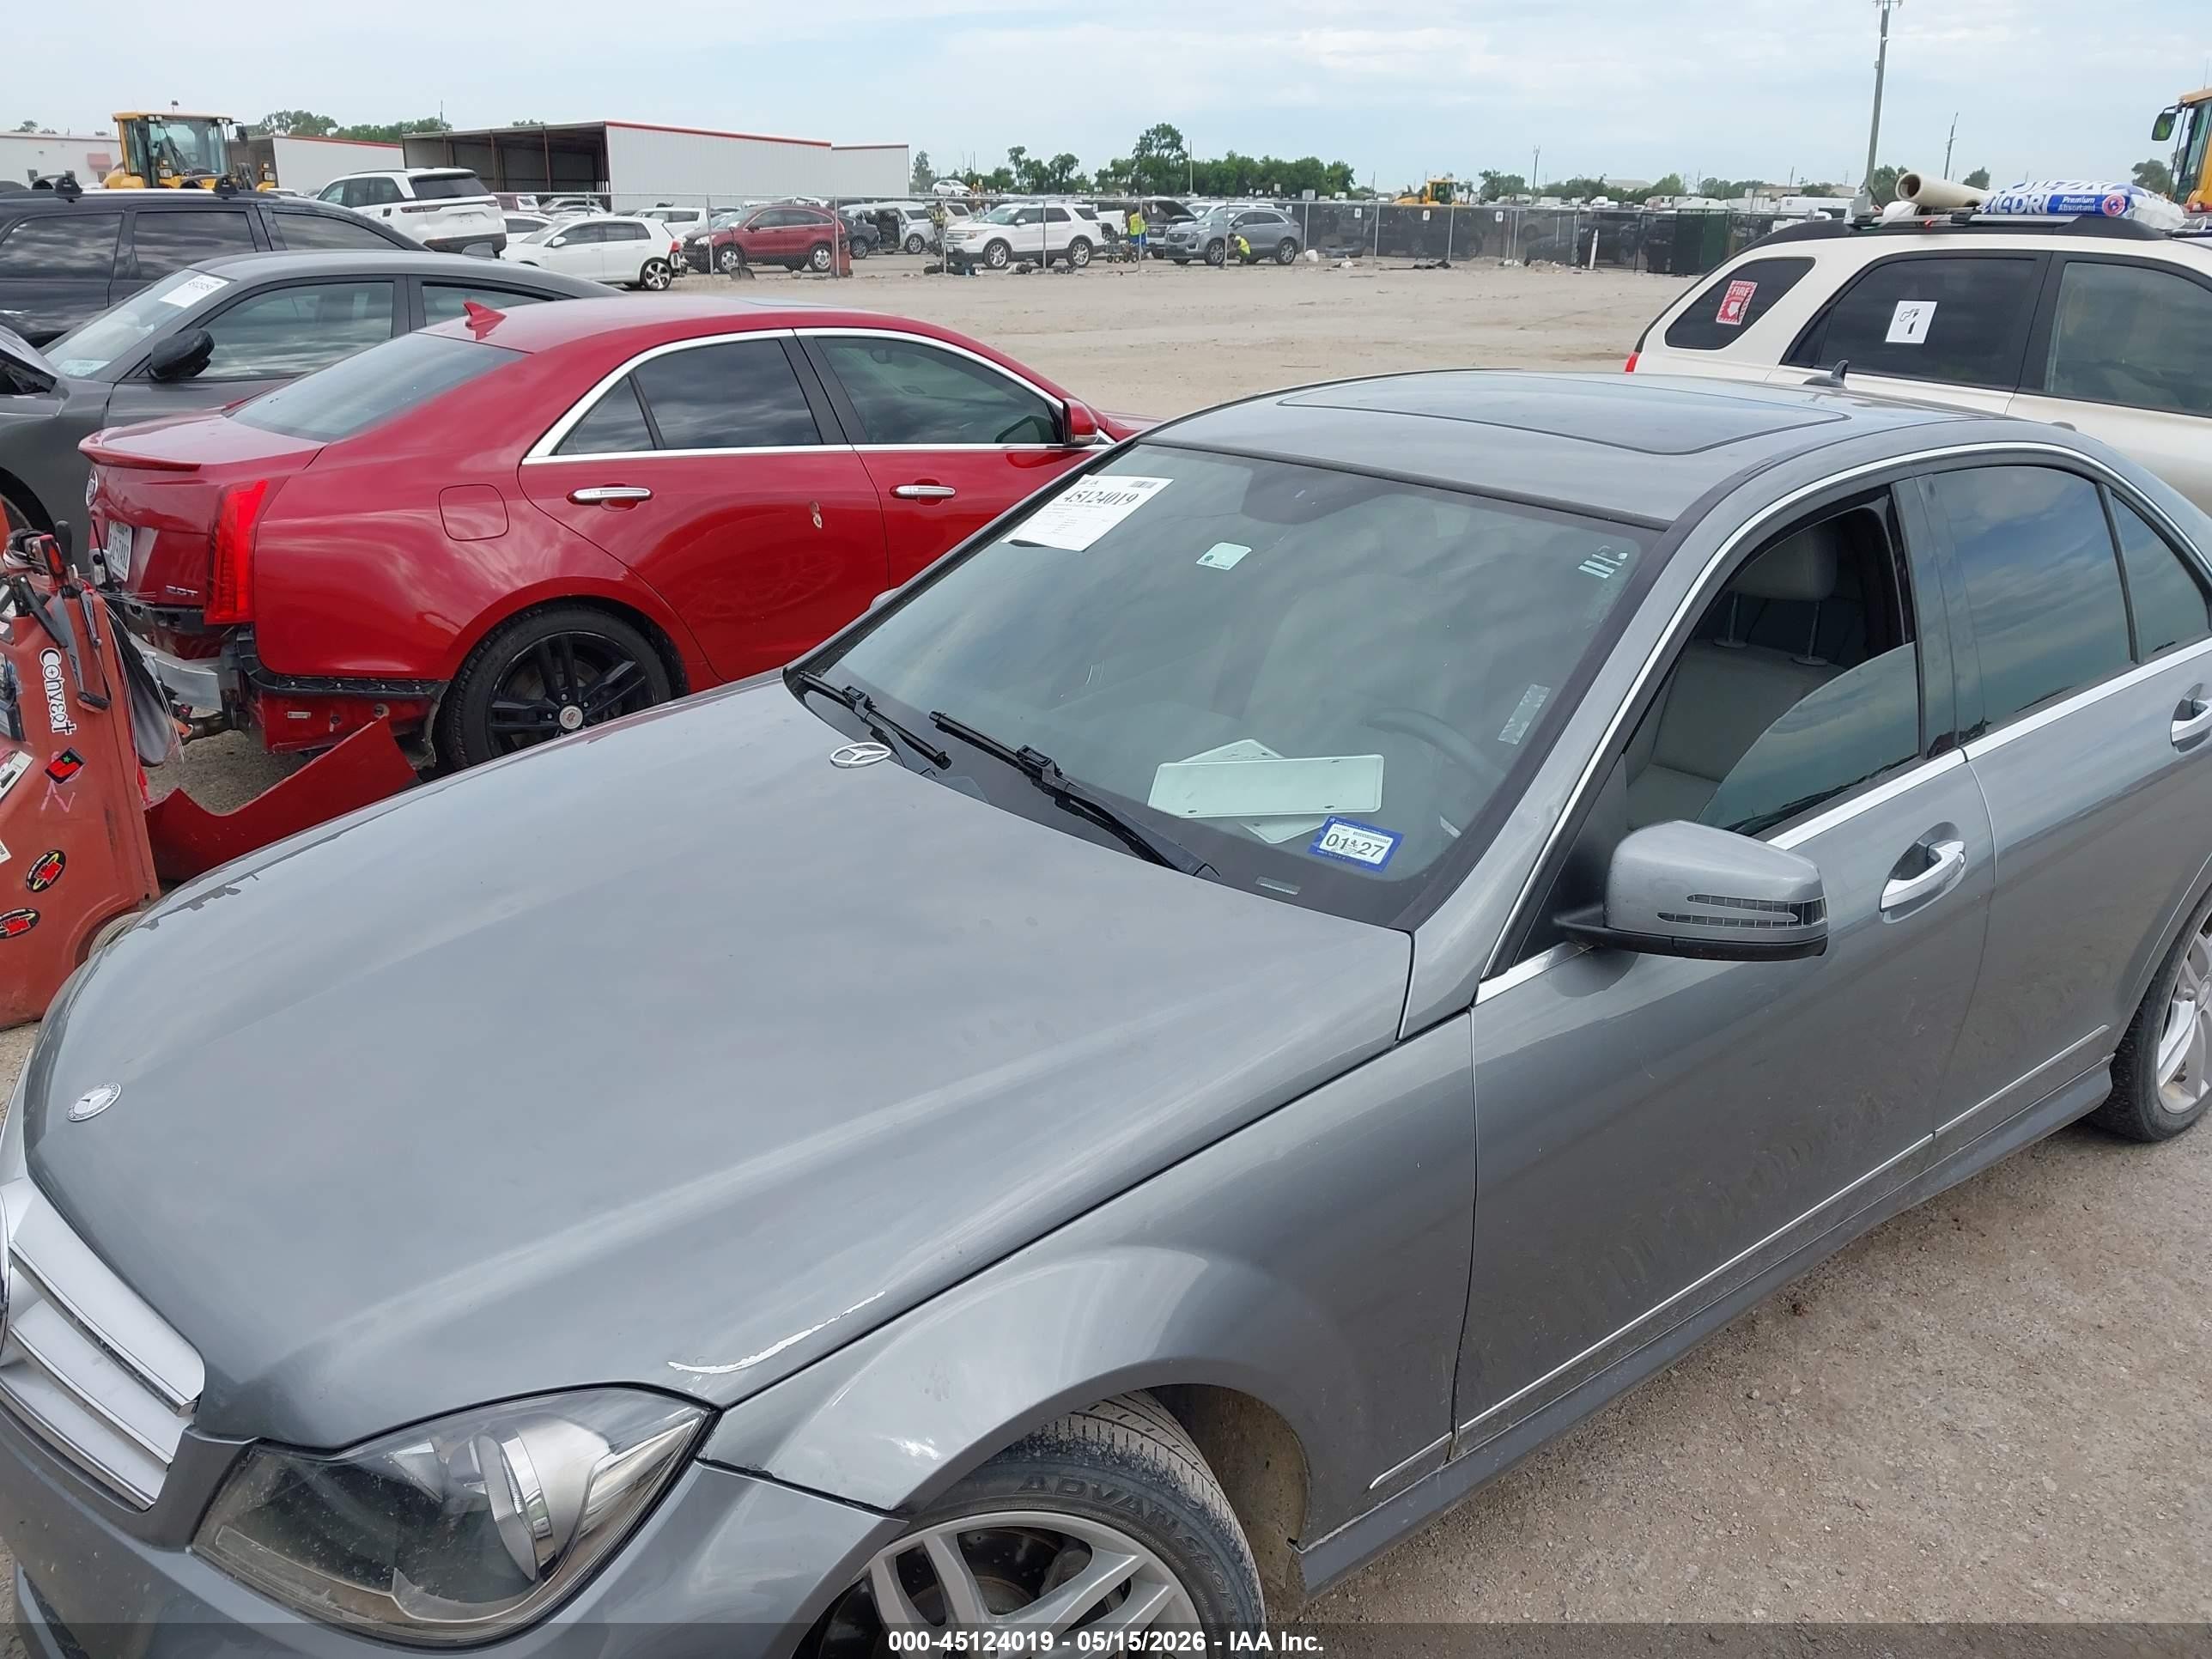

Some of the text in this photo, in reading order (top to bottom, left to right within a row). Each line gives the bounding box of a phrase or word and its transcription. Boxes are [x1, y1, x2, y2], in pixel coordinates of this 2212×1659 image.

[2062, 196, 2095, 204] Premium
[1064, 489, 1139, 506] 45124019
[1325, 833, 1350, 850] 01
[1357, 841, 1385, 858] 27
[1013, 1475, 1181, 1535] ADVAN
